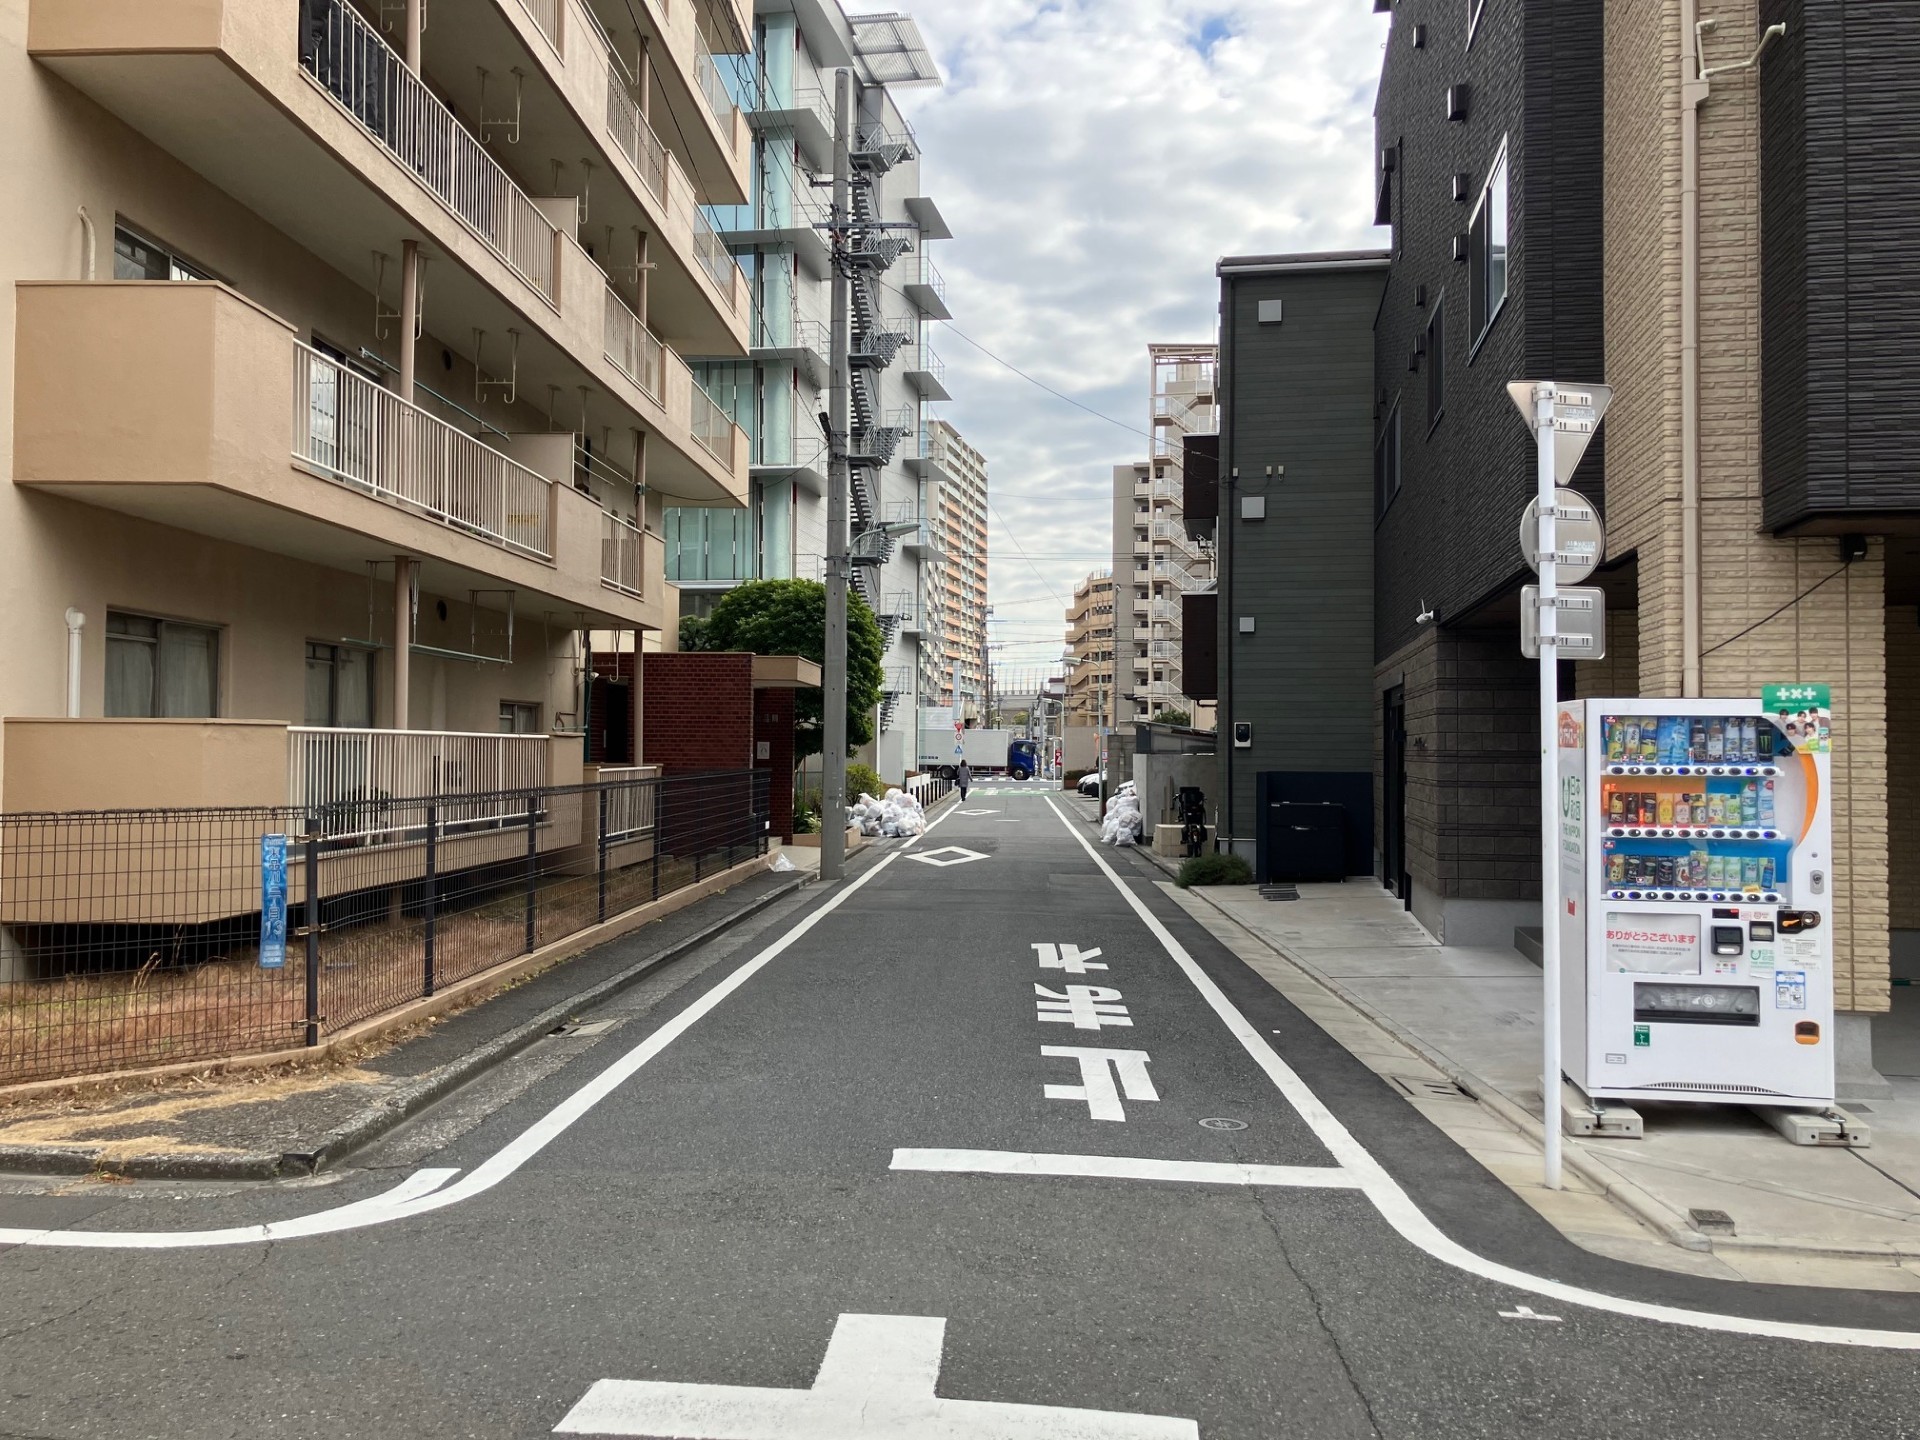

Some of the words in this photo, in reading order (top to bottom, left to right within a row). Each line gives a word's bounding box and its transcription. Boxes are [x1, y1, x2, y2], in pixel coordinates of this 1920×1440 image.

[1606, 930, 1697, 944] ありがとうございます
